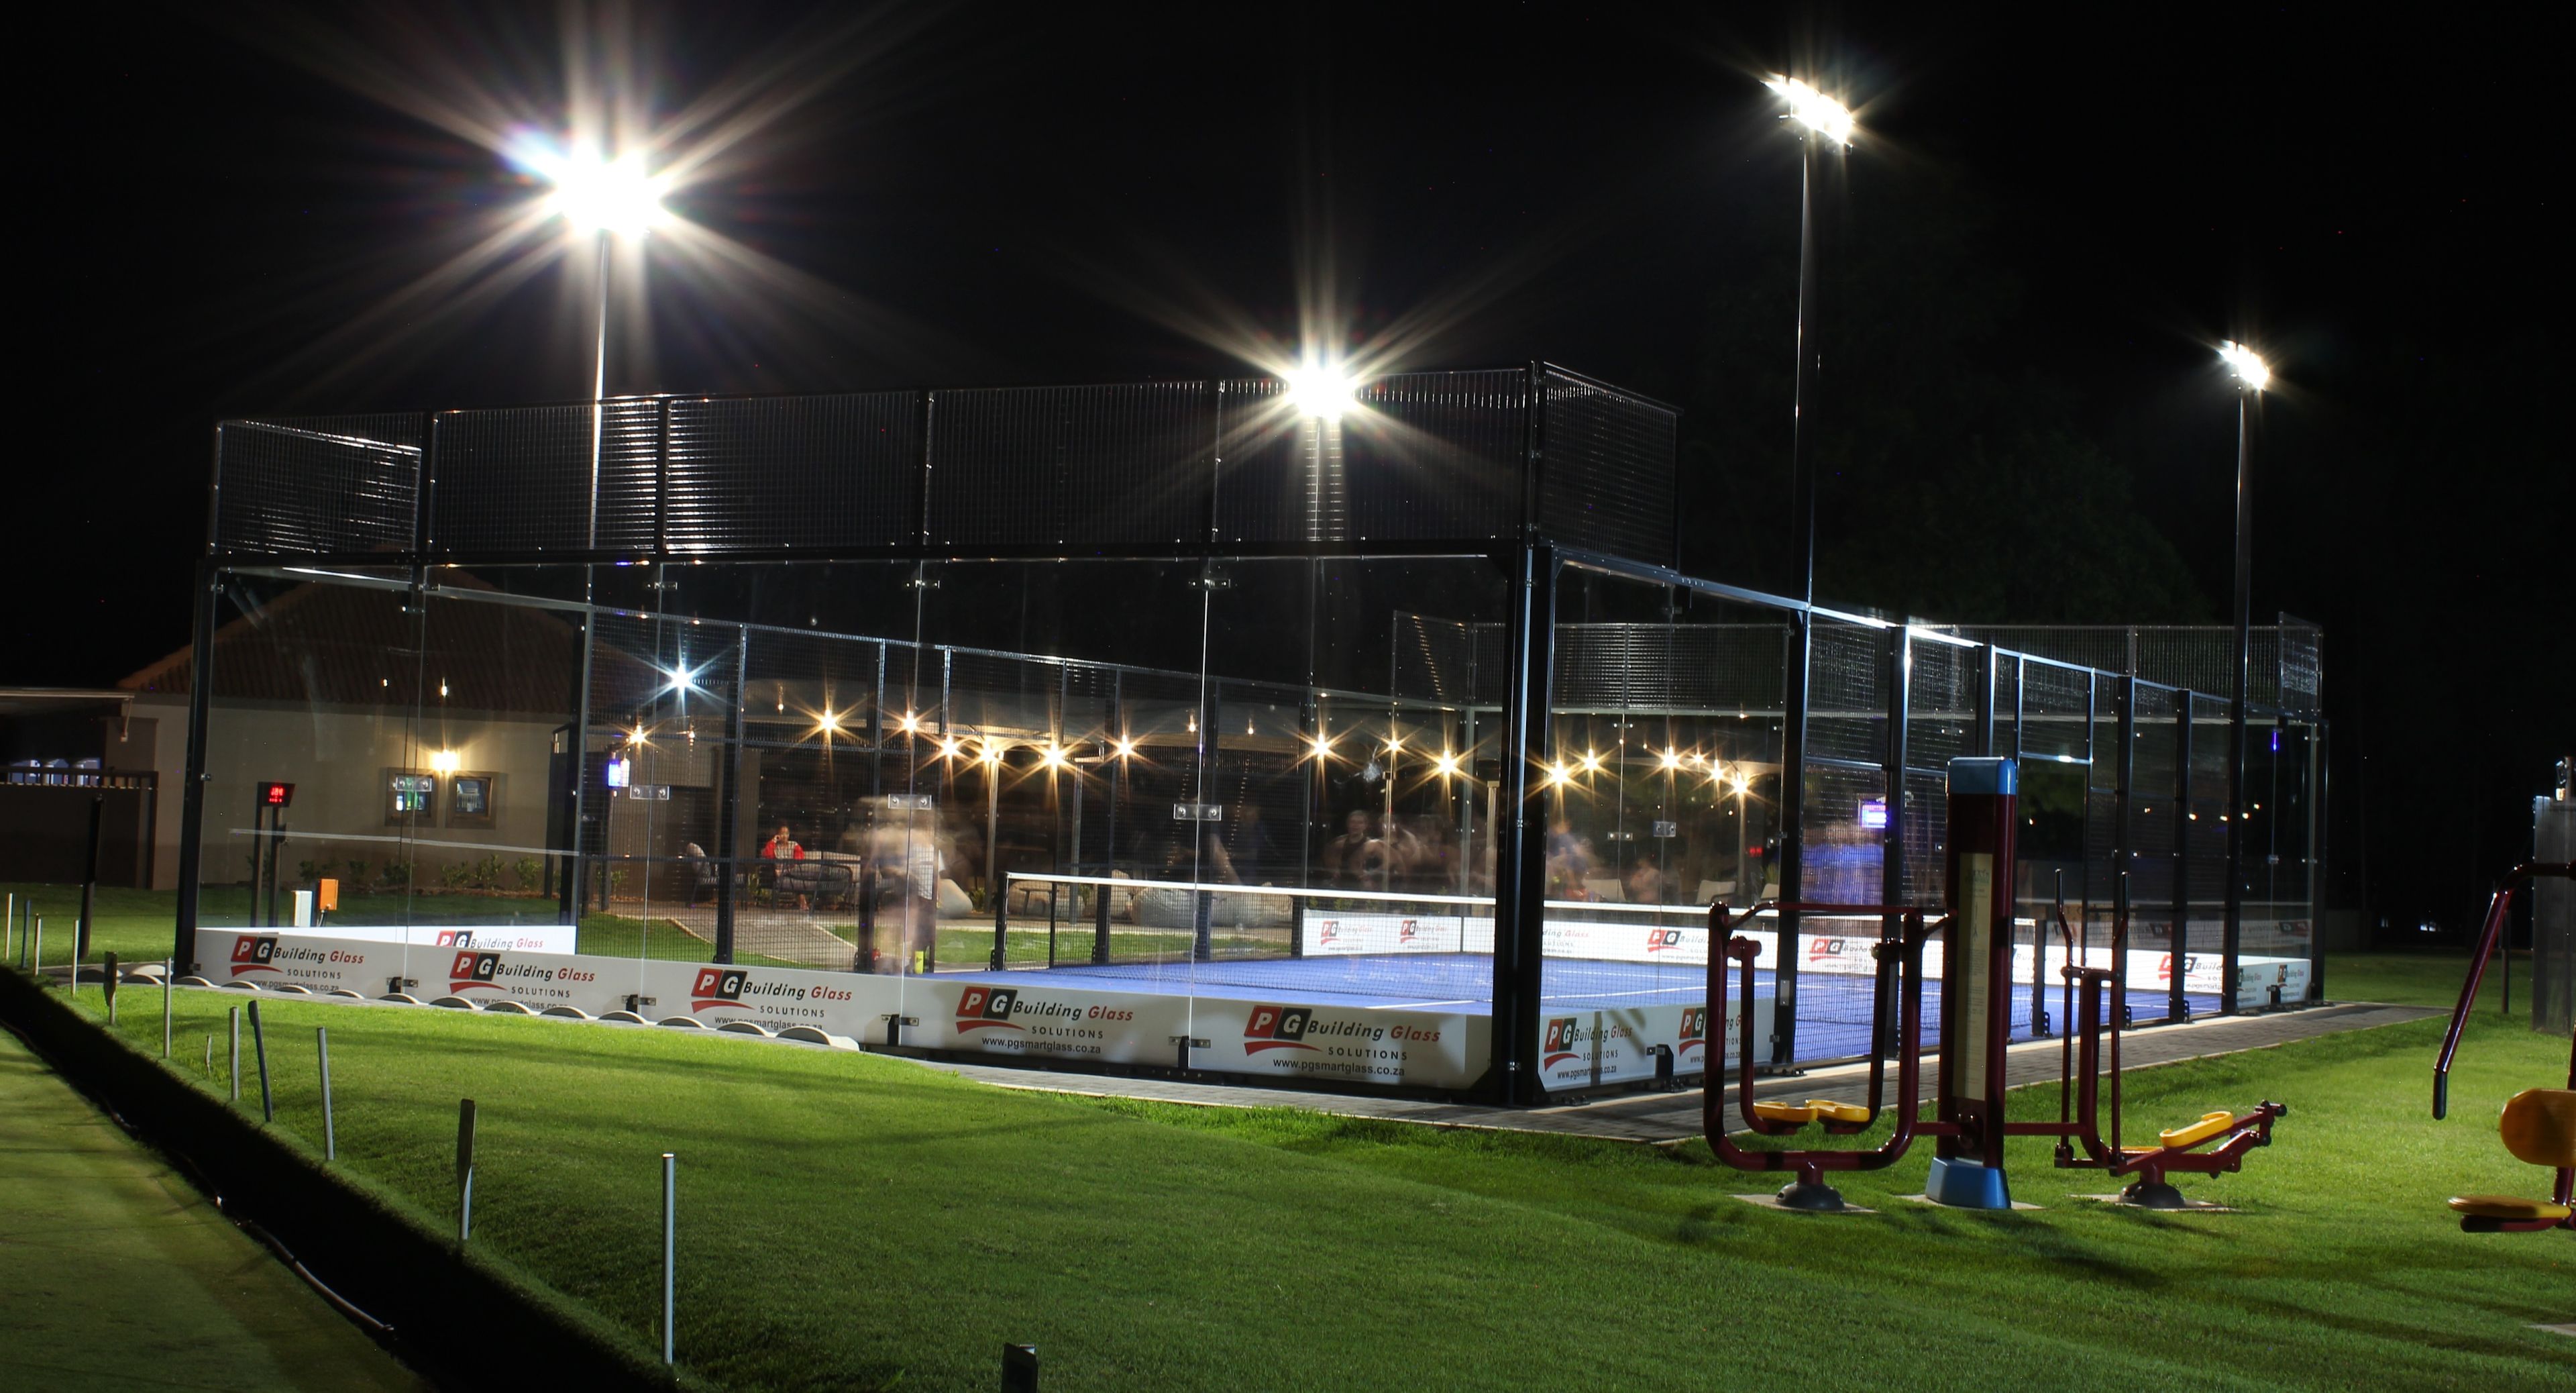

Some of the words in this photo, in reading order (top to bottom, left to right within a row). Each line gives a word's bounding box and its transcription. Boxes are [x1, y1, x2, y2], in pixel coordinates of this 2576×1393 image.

[1543, 929, 1562, 938] ding
[1680, 935, 1707, 943] Buildi
[470, 938, 513, 950] Building
[517, 938, 543, 948] Glass
[274, 947, 326, 964] Building
[330, 950, 365, 964] Glass
[496, 963, 553, 981] Building
[557, 968, 595, 982] Glass
[2196, 962, 2222, 970] Build
[287, 968, 341, 980] SOLUTIONS
[511, 986, 570, 998] SOLUTIONS
[743, 982, 806, 1000] Building
[811, 986, 852, 1001] Glass
[760, 1005, 825, 1018] SOLUTIONS
[1013, 1000, 1082, 1021] Building
[1088, 1006, 1133, 1021] Glass
[1032, 1026, 1103, 1039] SOLUTIONS
[1308, 1020, 1383, 1041] Building
[1391, 1025, 1440, 1041] Glass
[1574, 1027, 1608, 1042] Building
[1611, 1025, 1632, 1038] Glass
[982, 1037, 1101, 1054] www.pgsmartglass.co.za
[1328, 1047, 1407, 1060] SOLUTIONS
[1583, 1049, 1618, 1061] SOLUTIONS
[1273, 1059, 1405, 1076] www.pgsmartglass.co.za
